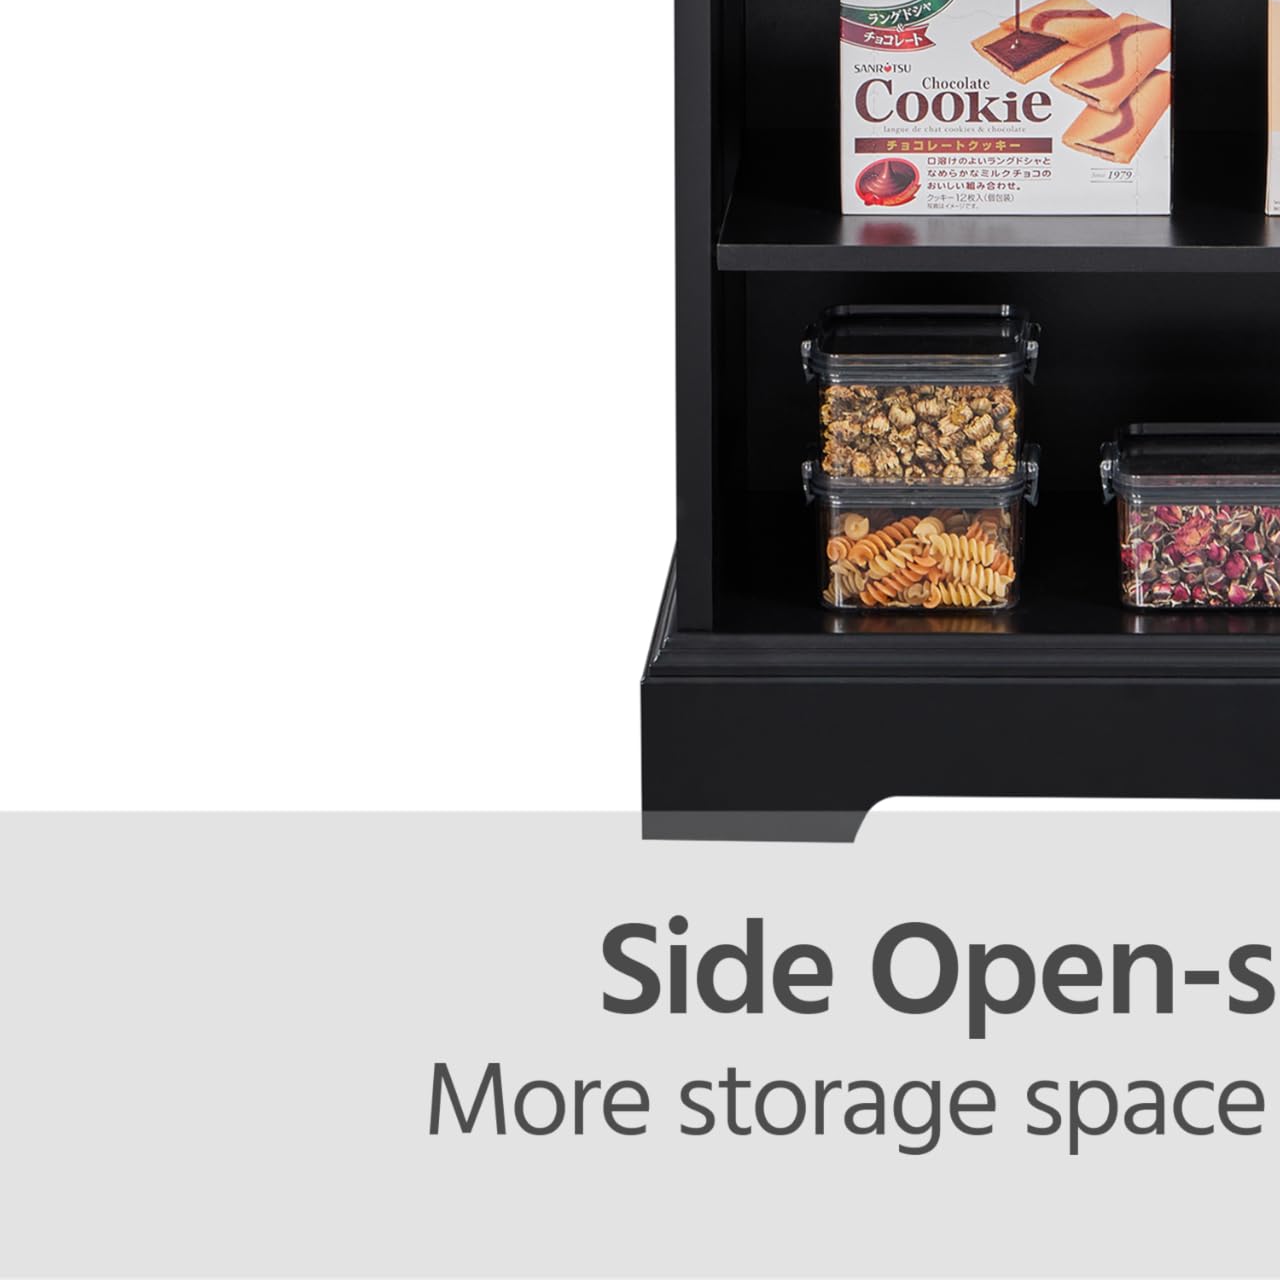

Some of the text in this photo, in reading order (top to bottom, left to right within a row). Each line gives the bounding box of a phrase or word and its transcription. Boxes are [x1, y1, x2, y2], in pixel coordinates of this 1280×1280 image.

[868, 1, 932, 25] ラングドシャ
[863, 31, 923, 47] チョコレート
[922, 76, 990, 90] Chocolate
[855, 78, 1052, 123] Cookie
[886, 139, 1021, 151] チョコレートクッキー
[927, 169, 1052, 178] なめらかなミルクチョコの
[1108, 170, 1133, 180] 1979
